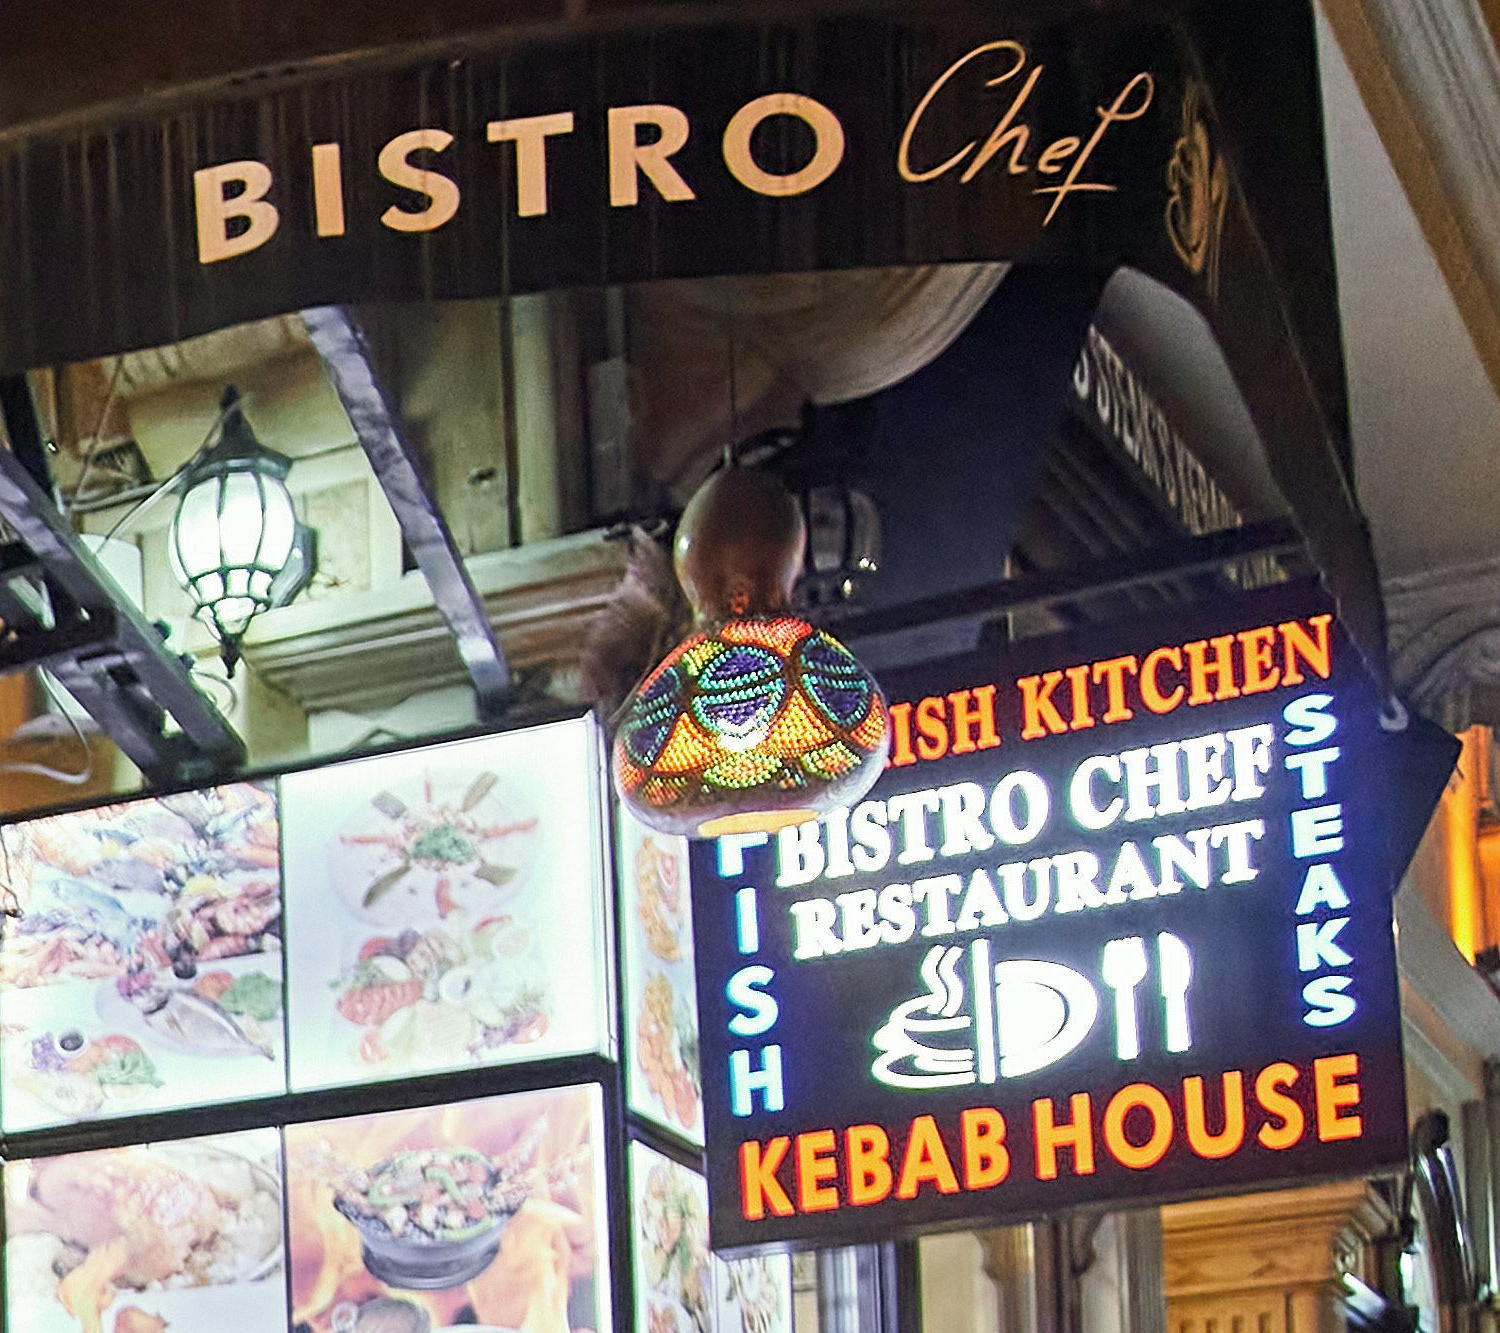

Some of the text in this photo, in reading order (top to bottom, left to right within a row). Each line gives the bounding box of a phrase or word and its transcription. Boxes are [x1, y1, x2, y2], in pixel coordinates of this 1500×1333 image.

[193, 40, 1155, 264] BISTRO Chef
[885, 614, 1334, 769] ISH KITCHEN
[776, 723, 1274, 888] BISTRO CHEF
[790, 820, 1265, 961] RESTAURANT
[1284, 694, 1357, 1027] STEAKS
[717, 831, 785, 1118] FISH
[740, 1053, 1364, 1223] KEBAB HOUSE
